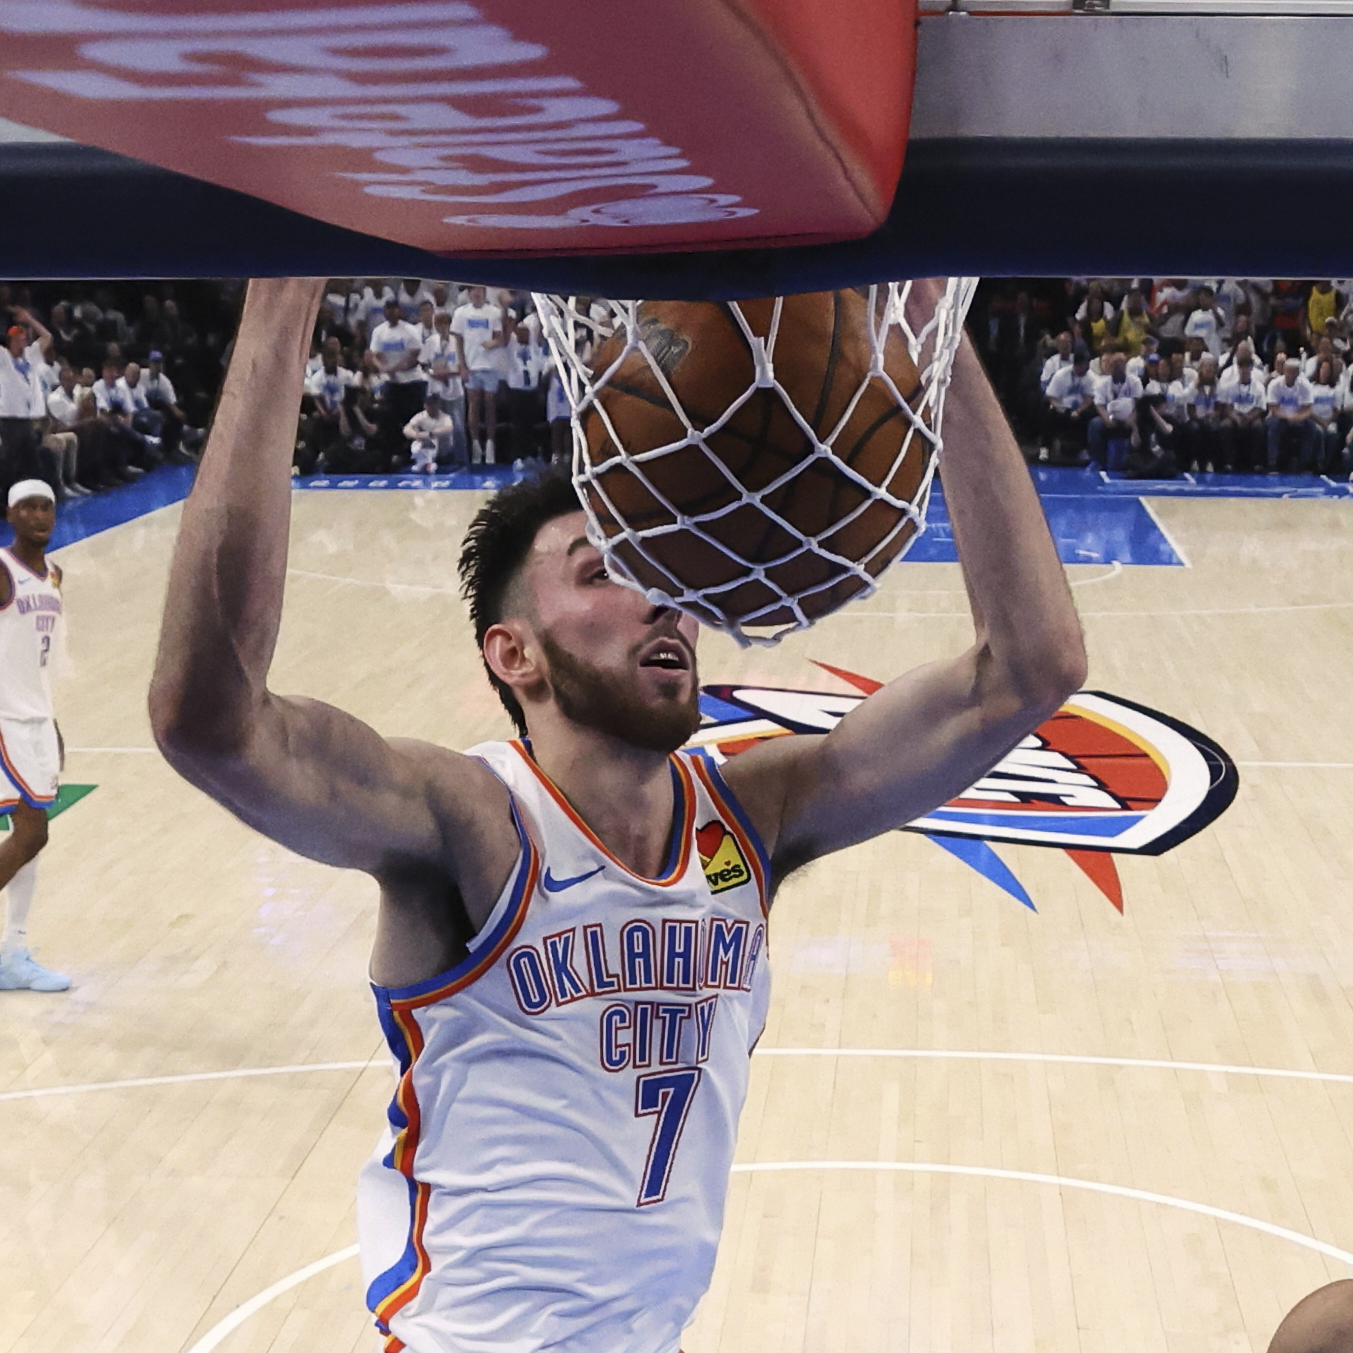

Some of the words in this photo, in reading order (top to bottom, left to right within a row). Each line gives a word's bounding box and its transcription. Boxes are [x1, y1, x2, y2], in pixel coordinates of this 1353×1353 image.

[40, 635, 51, 668] 2
[599, 993, 719, 1074] CITY
[633, 1066, 703, 1208] 7
